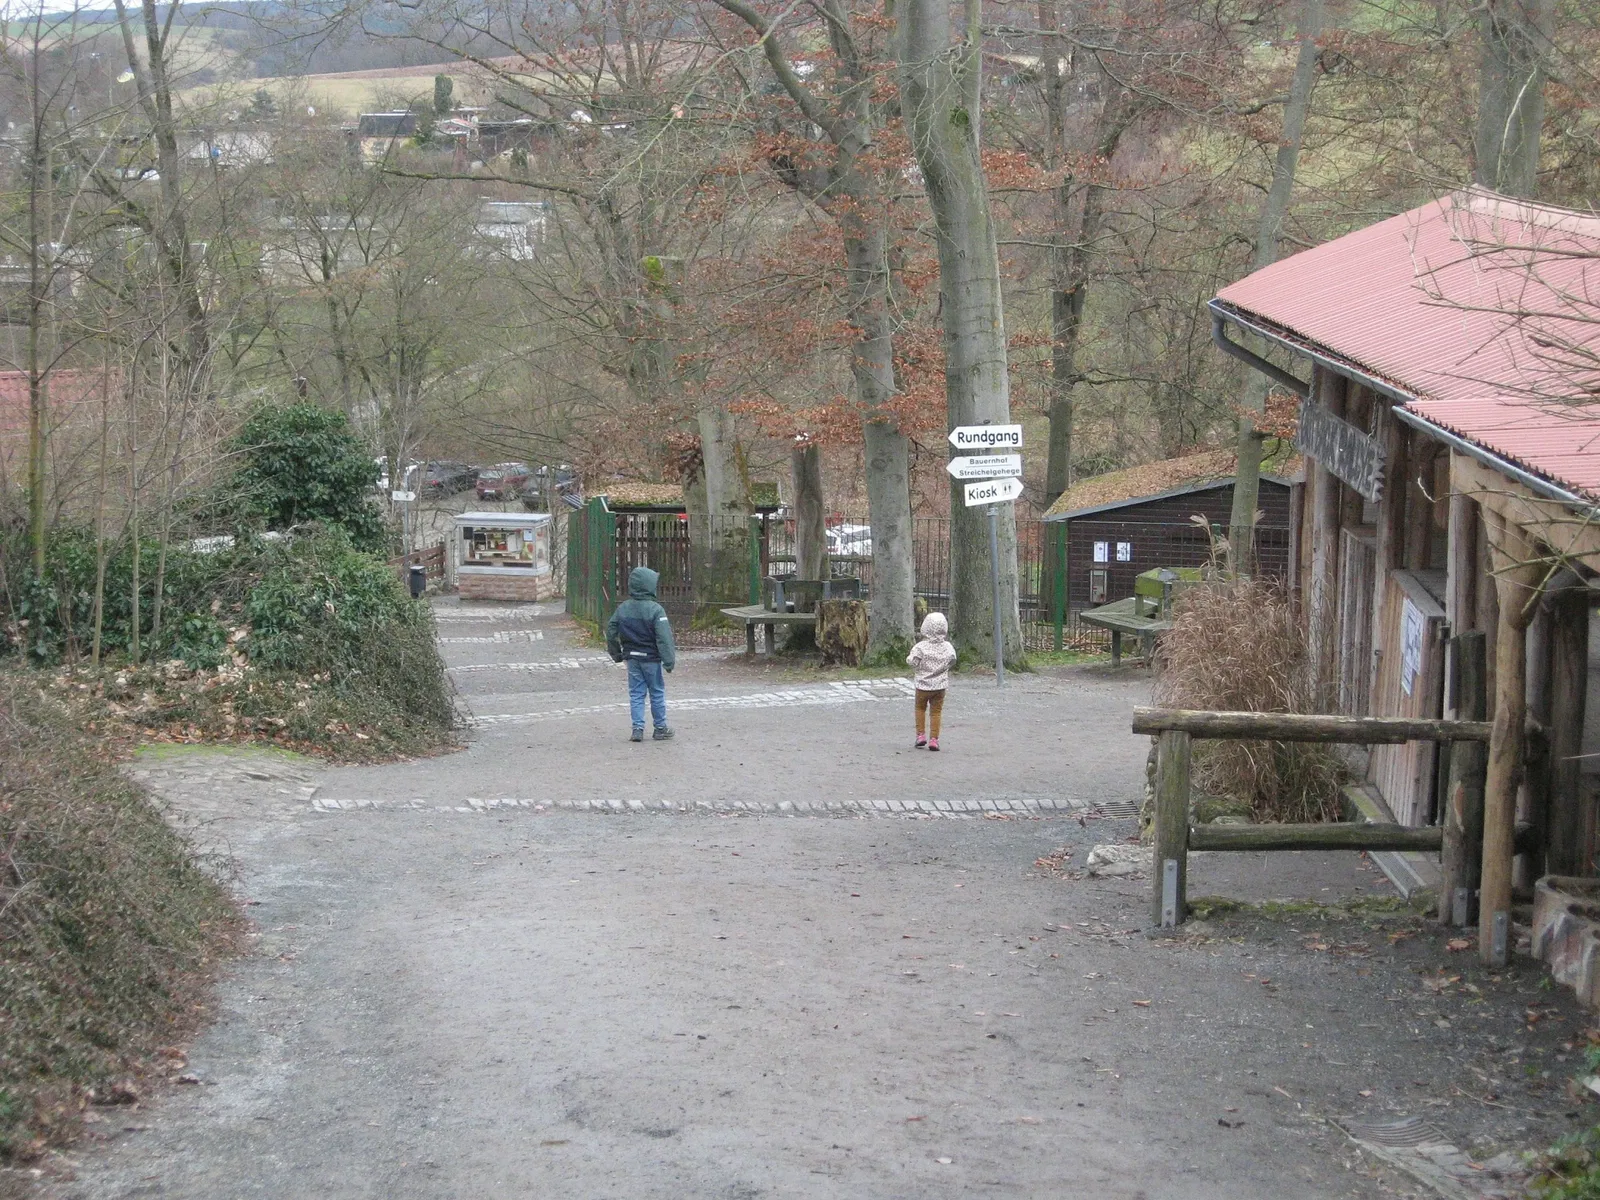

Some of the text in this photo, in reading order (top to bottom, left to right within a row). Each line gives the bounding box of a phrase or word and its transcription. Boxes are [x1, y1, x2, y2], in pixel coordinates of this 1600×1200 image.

[957, 430, 1019, 445] Rundgang
[969, 457, 1008, 465] Bauernhof
[959, 468, 1020, 477] Streichelgehege
[968, 485, 998, 500] Kiosk
